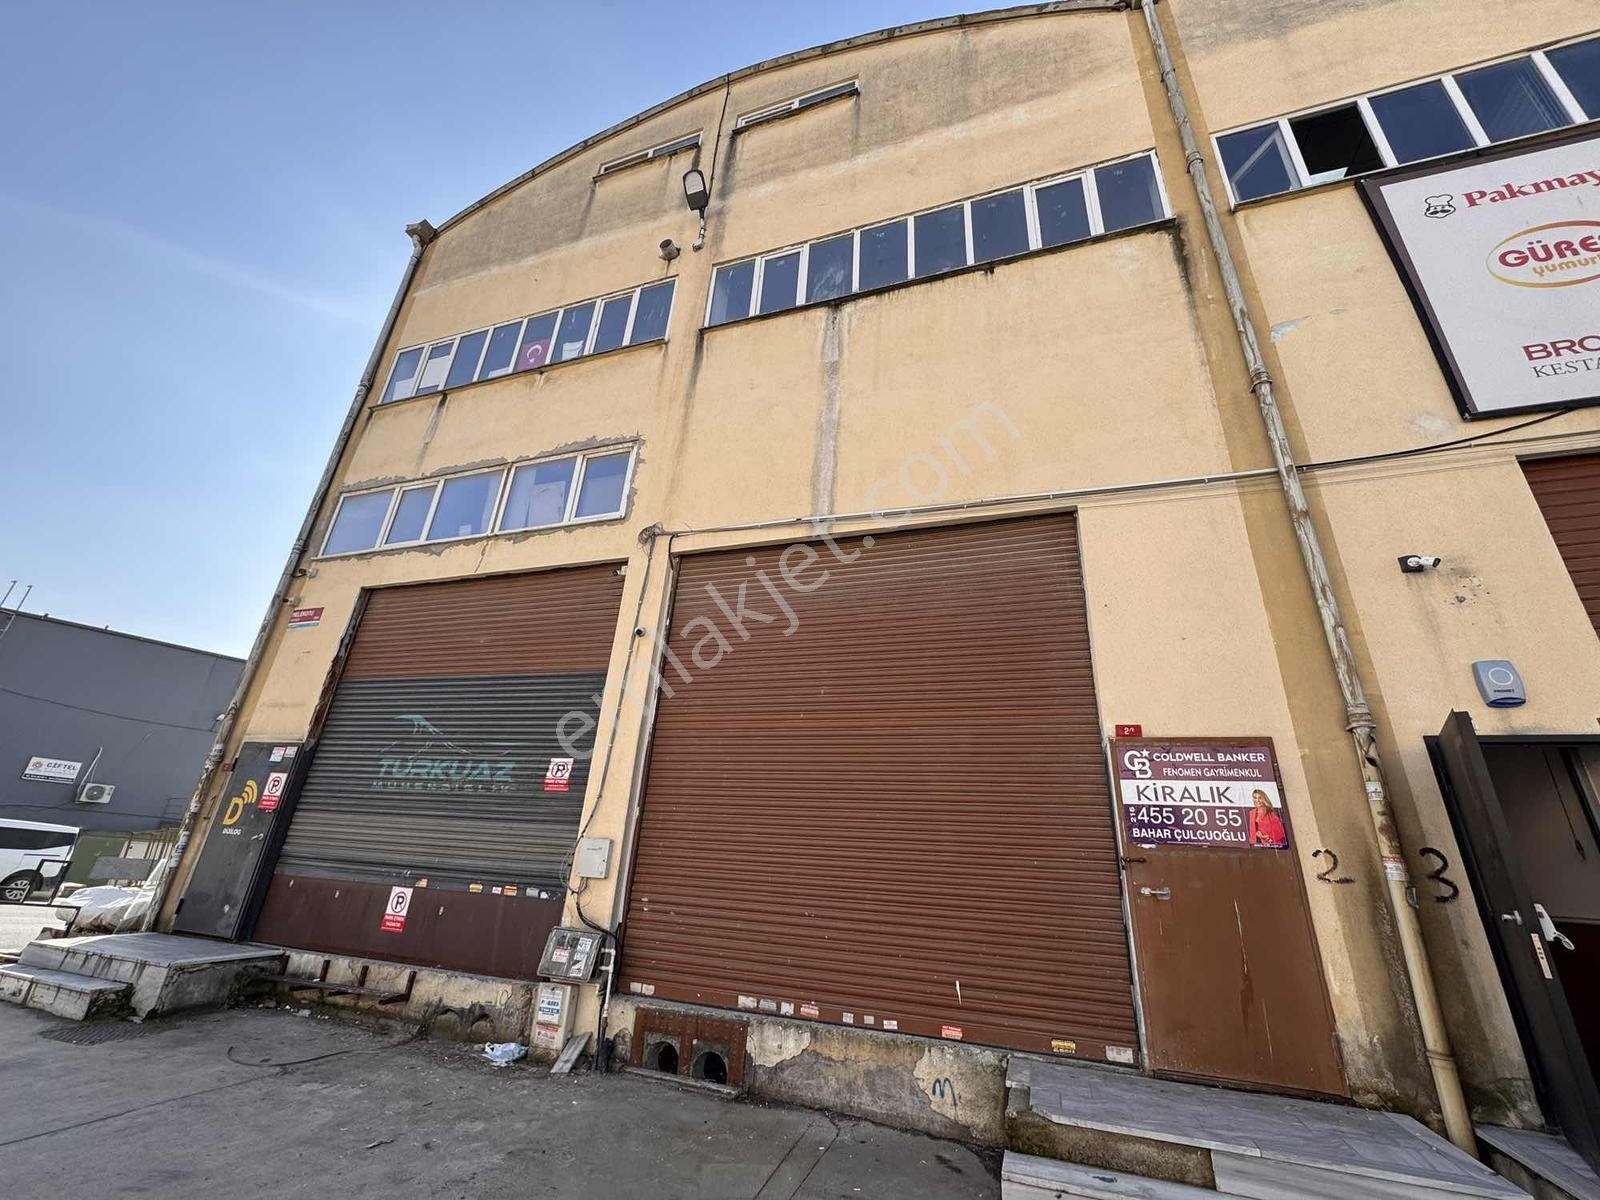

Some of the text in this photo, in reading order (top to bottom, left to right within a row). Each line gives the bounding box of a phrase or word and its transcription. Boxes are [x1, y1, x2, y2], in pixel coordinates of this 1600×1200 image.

[1461, 170, 1600, 208] Pakmay
[1498, 234, 1600, 268] GÜRE
[1532, 253, 1600, 277] yumur
[1532, 357, 1600, 378] KEST
[1153, 753, 1265, 763] COLDWELL BANKER
[1163, 766, 1262, 777] FENOMEN GAYRİMENKUL
[1136, 783, 1234, 803] KİRALIK
[1129, 807, 1242, 827] 216 455 20 55
[1133, 828, 1247, 842] BAHAR ÇULCUOĞLU
[1312, 849, 1355, 883] 2
[1419, 847, 1459, 903] 3
